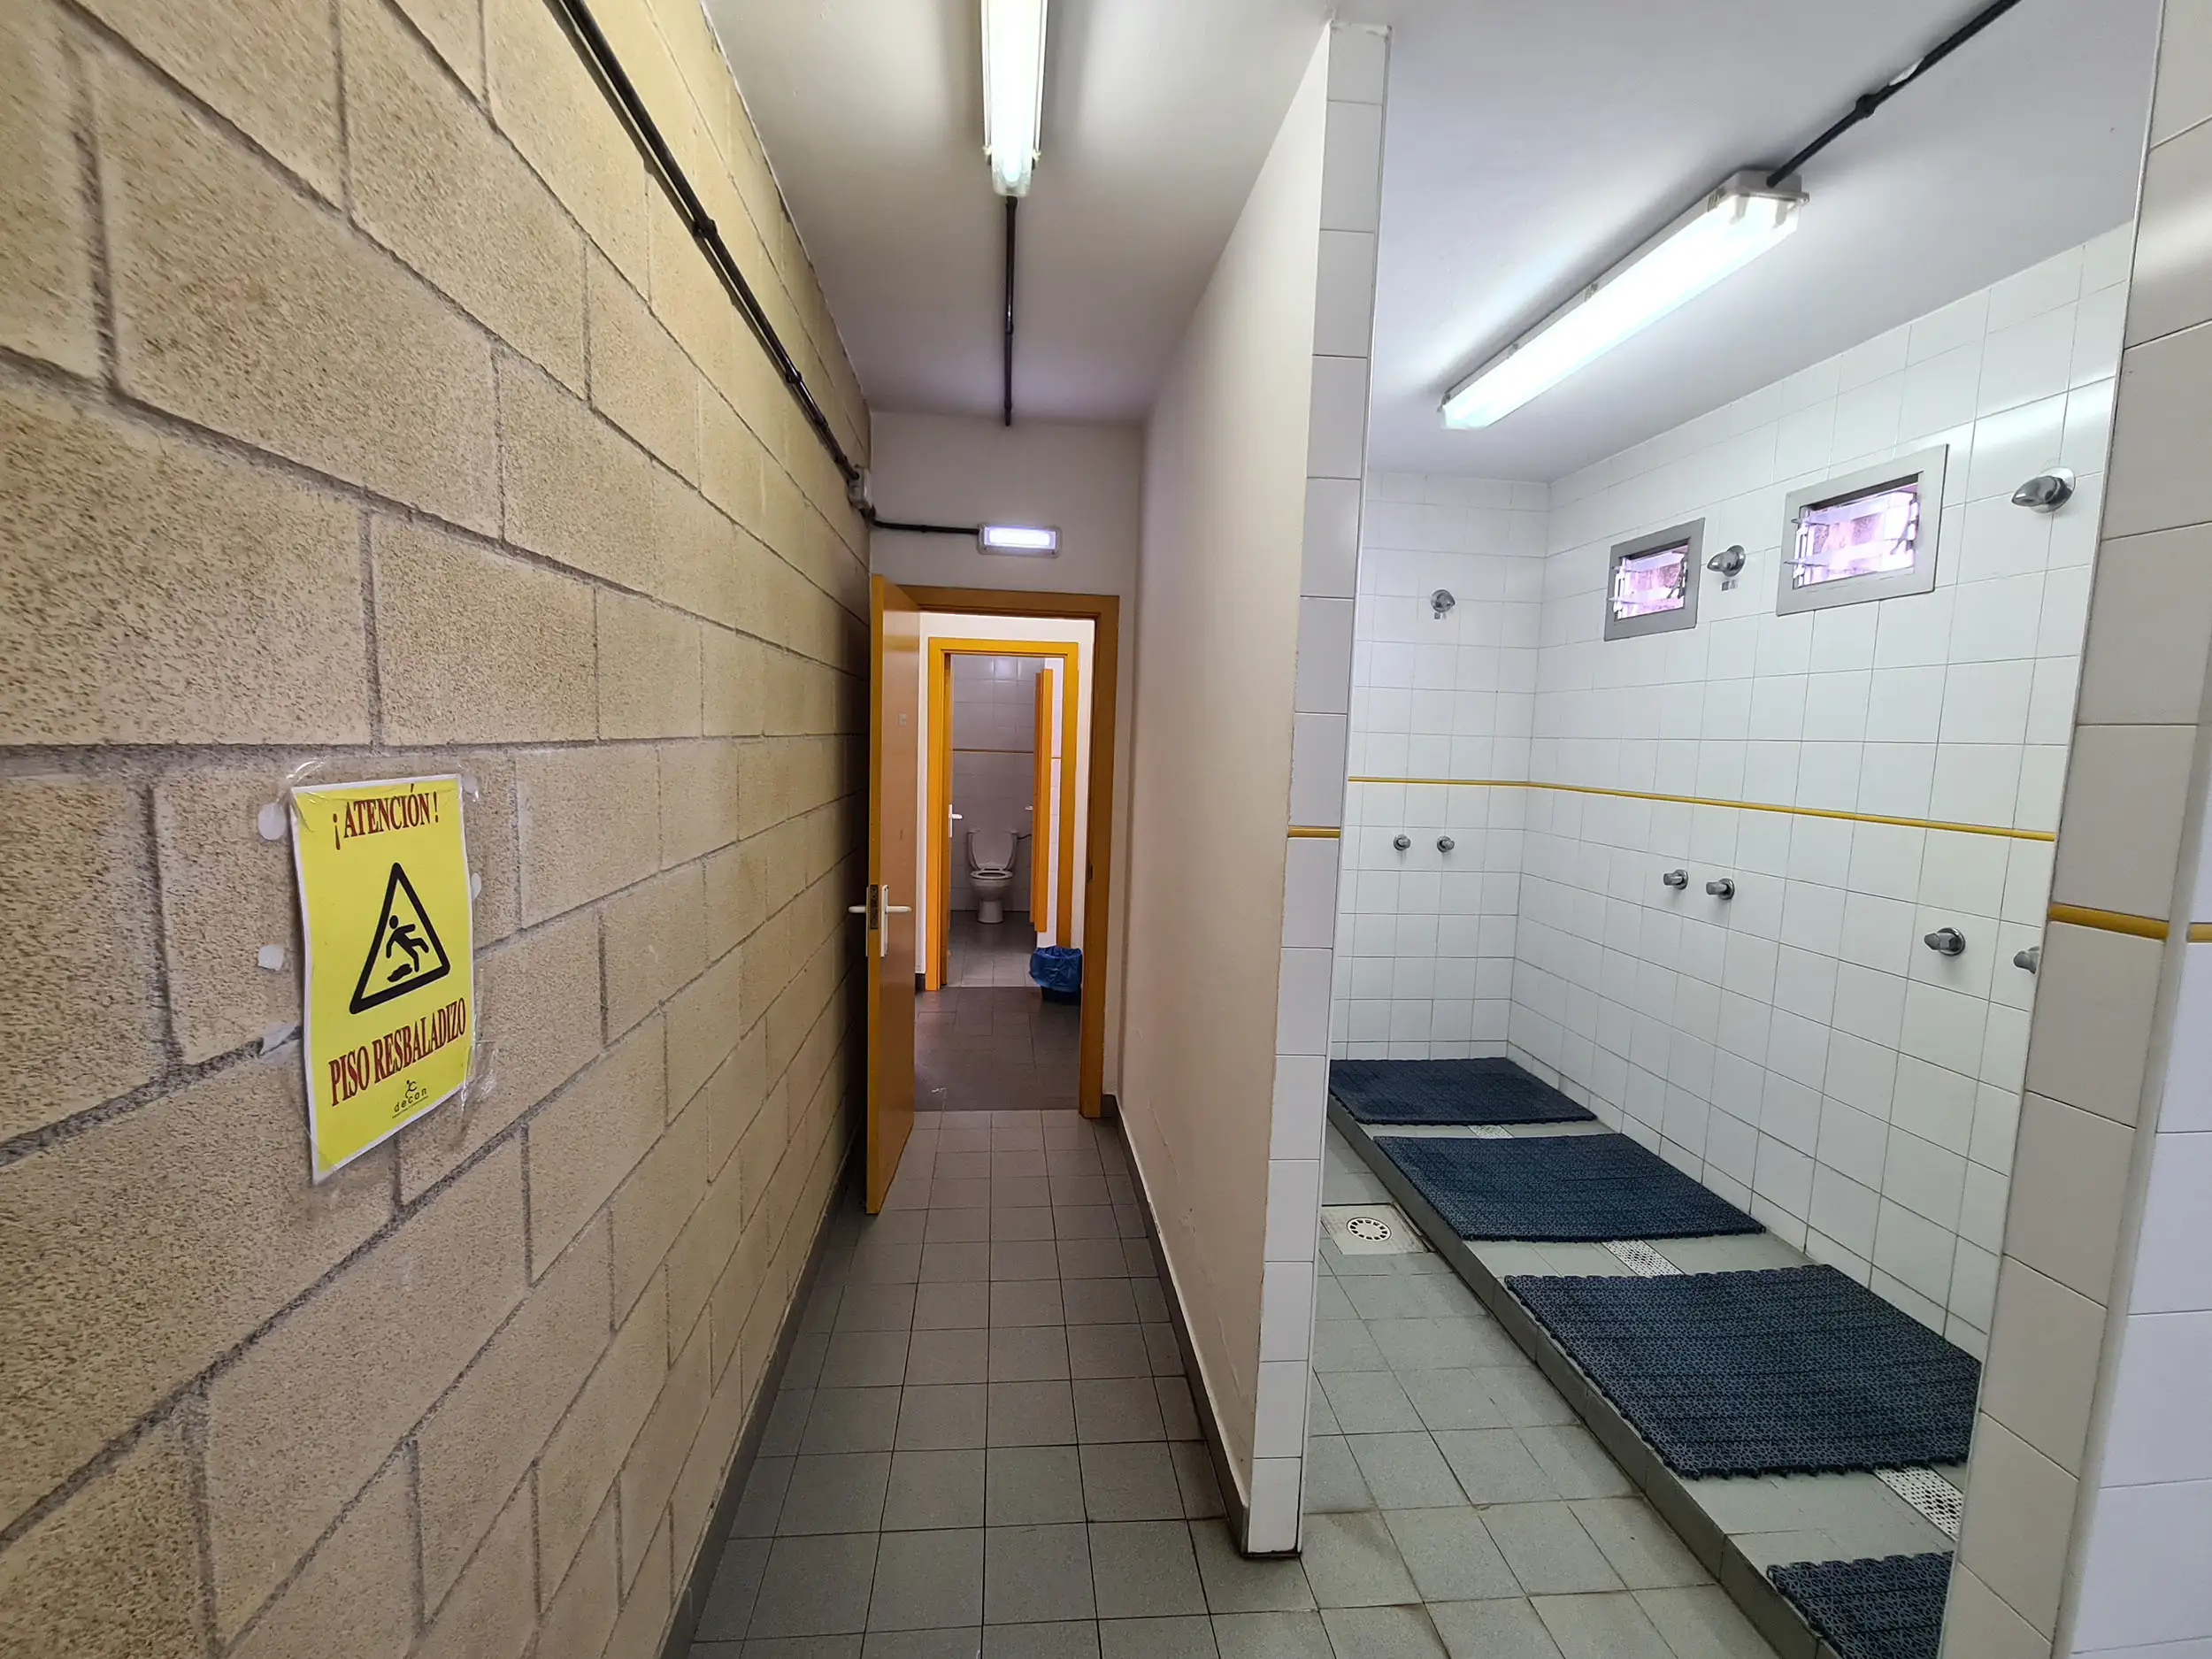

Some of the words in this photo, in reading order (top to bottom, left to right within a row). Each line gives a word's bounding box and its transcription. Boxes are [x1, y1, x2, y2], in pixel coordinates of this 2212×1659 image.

[328, 1046, 370, 1107] PISO
[372, 997, 466, 1084] RESBALADIZO
[394, 1087, 426, 1113] decon
